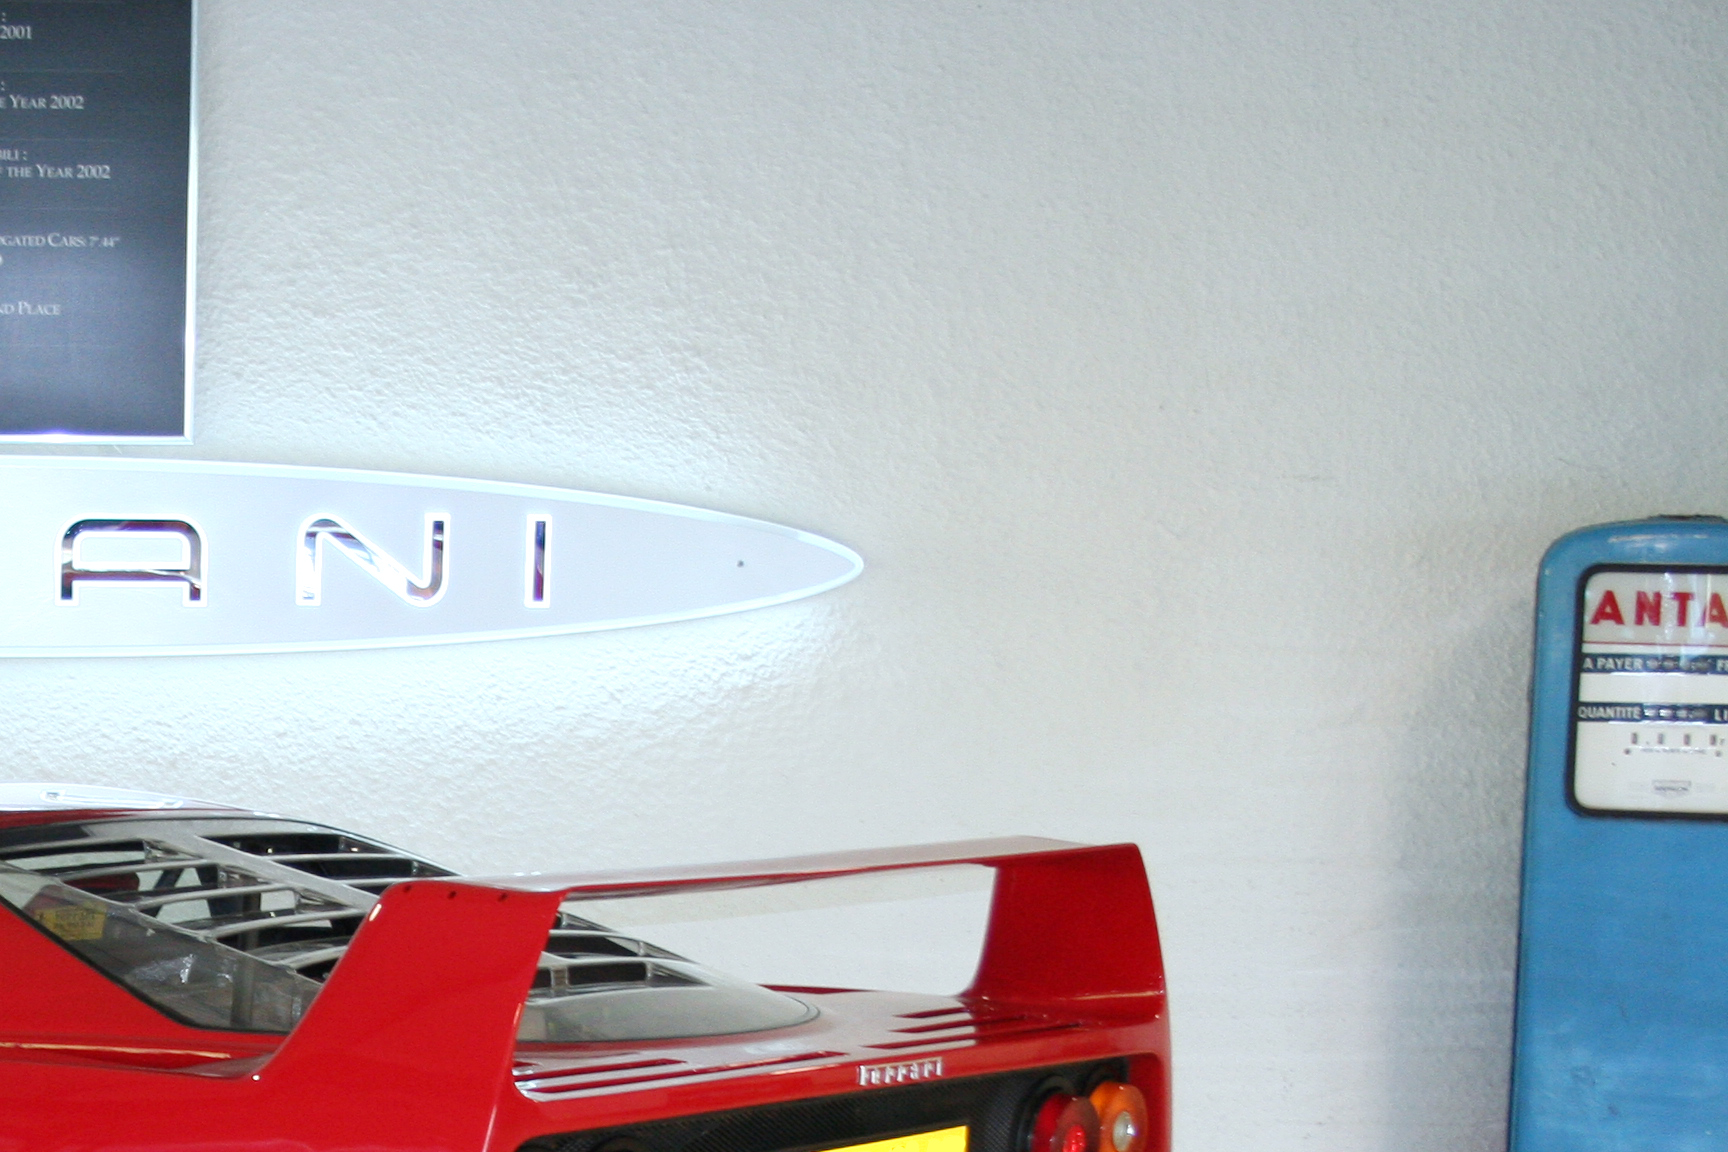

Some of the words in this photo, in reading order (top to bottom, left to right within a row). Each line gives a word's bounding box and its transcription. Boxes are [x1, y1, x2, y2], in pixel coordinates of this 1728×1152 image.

[8, 93, 47, 110] YEAR
[49, 94, 85, 110] 2002
[6, 166, 33, 178] THE
[35, 163, 74, 179] YEAR
[76, 163, 112, 180] 2002
[17, 300, 62, 316] PLACE
[1583, 658, 1594, 670] A
[1597, 658, 1644, 670] PAYER
[857, 1056, 943, 1086] Ferrari
